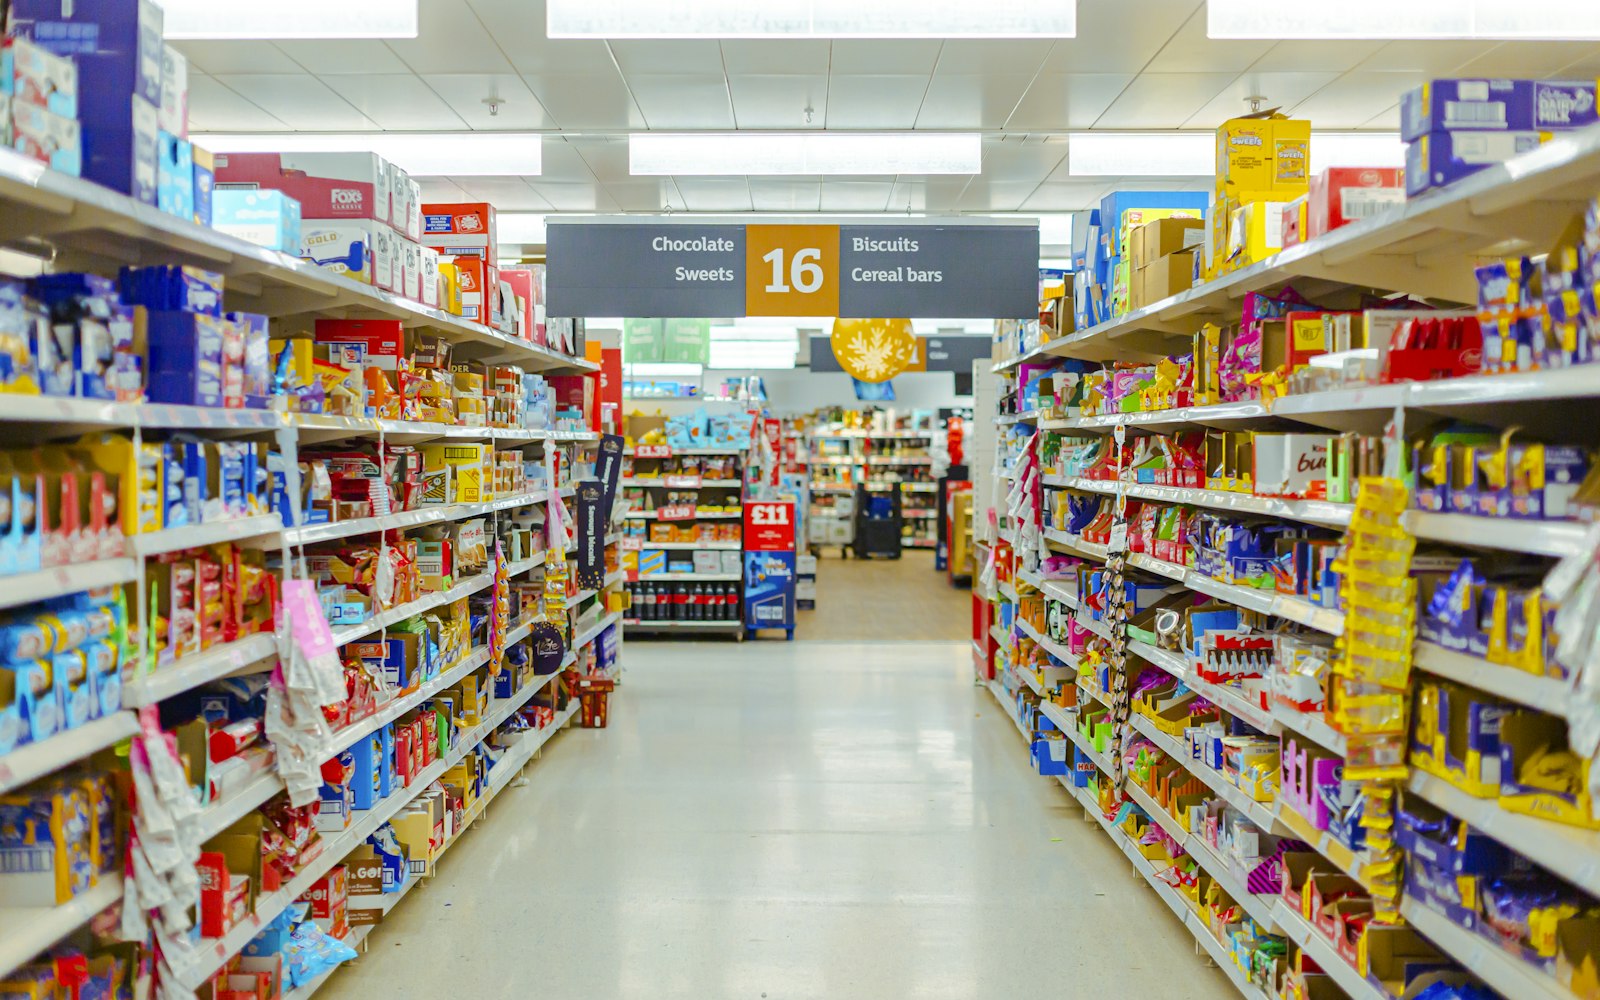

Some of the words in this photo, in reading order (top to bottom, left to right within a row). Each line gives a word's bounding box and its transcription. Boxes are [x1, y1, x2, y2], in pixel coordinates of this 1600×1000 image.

[1231, 135, 1263, 146] SWEETS
[307, 233, 337, 245] GOLD
[652, 237, 734, 252] Chocolate
[852, 237, 919, 252] Biscuits
[675, 266, 734, 282] Sweets
[763, 248, 824, 293] 16
[851, 266, 903, 283] Cereal
[907, 266, 943, 283] bars
[587, 505, 596, 536] Savoury
[751, 505, 789, 525] £11
[587, 536, 596, 567] biscuits
[357, 867, 382, 879] GO!
